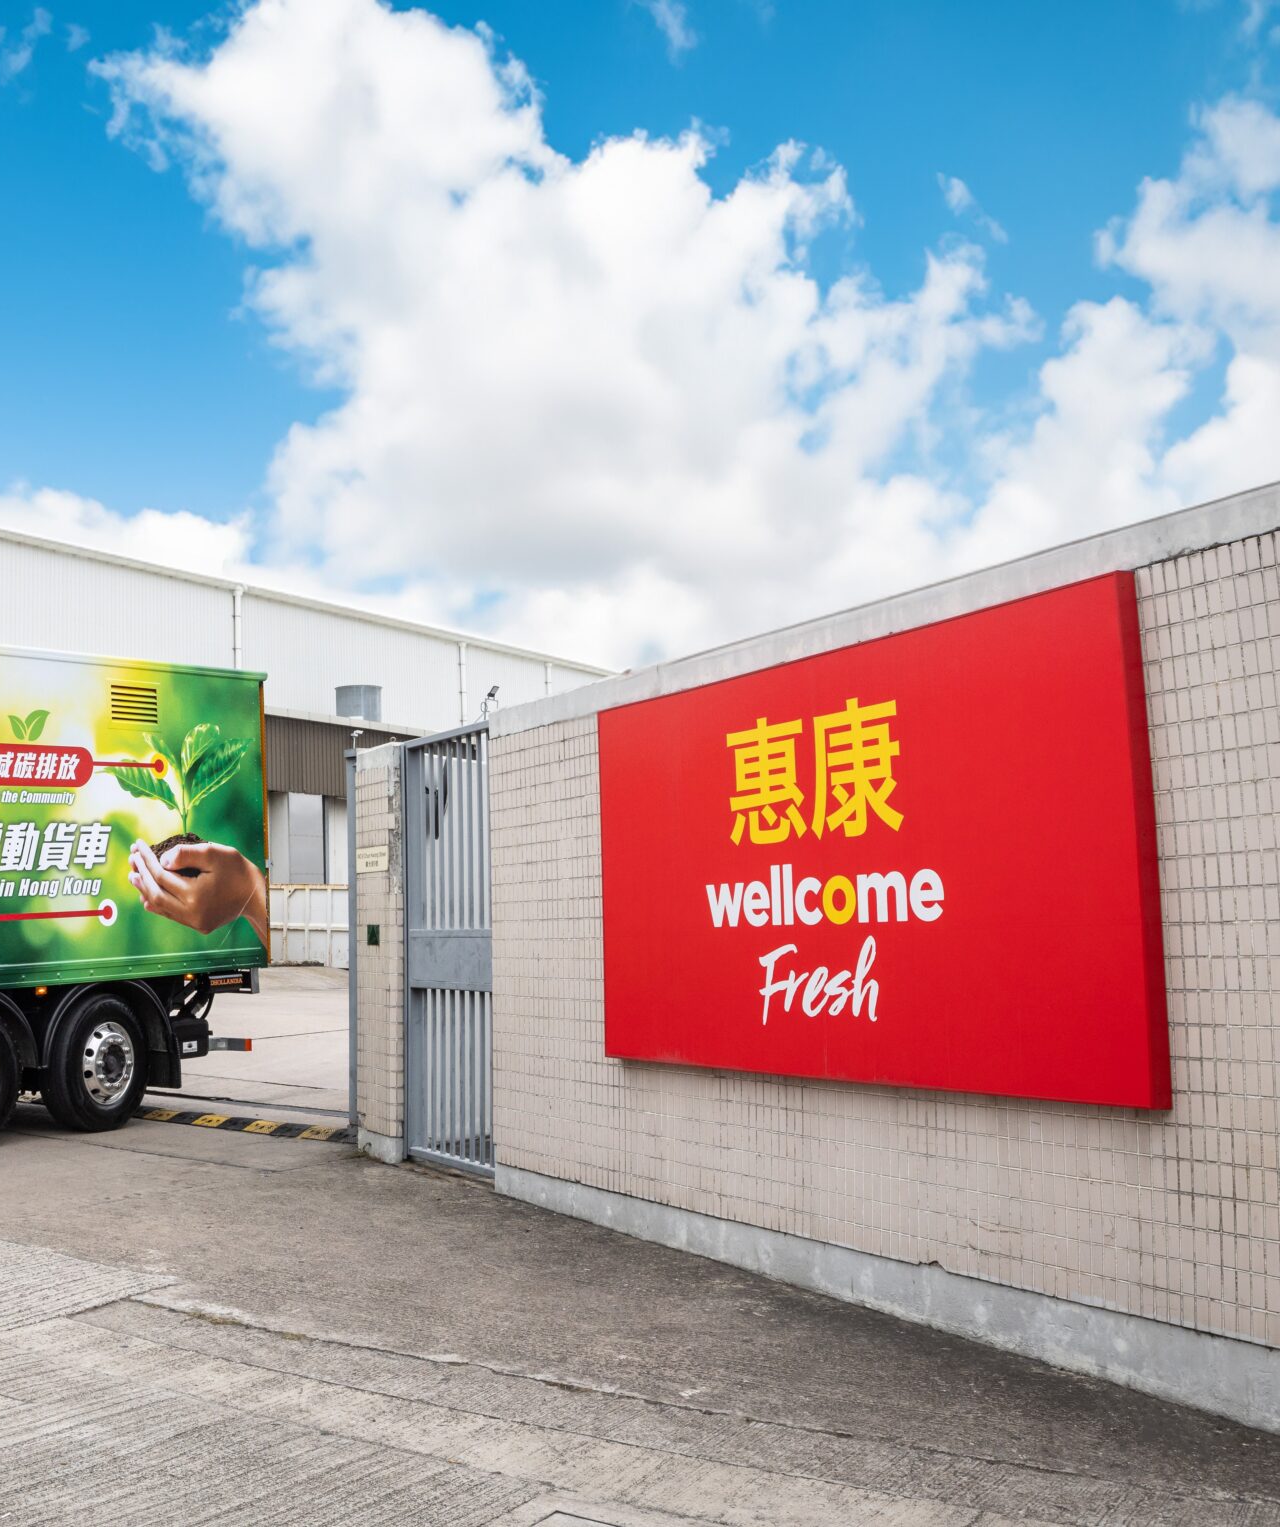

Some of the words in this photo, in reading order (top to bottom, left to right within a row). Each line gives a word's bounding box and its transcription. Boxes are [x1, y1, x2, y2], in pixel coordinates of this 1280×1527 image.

[726, 697, 904, 846] 惠康
[1, 791, 19, 803] the
[19, 791, 75, 805] Community
[18, 877, 59, 899] Hong
[63, 876, 102, 897] Kong
[705, 864, 945, 928] wellcome
[210, 977, 243, 986] DHOLLANDIA
[759, 936, 880, 1026] Fresh
